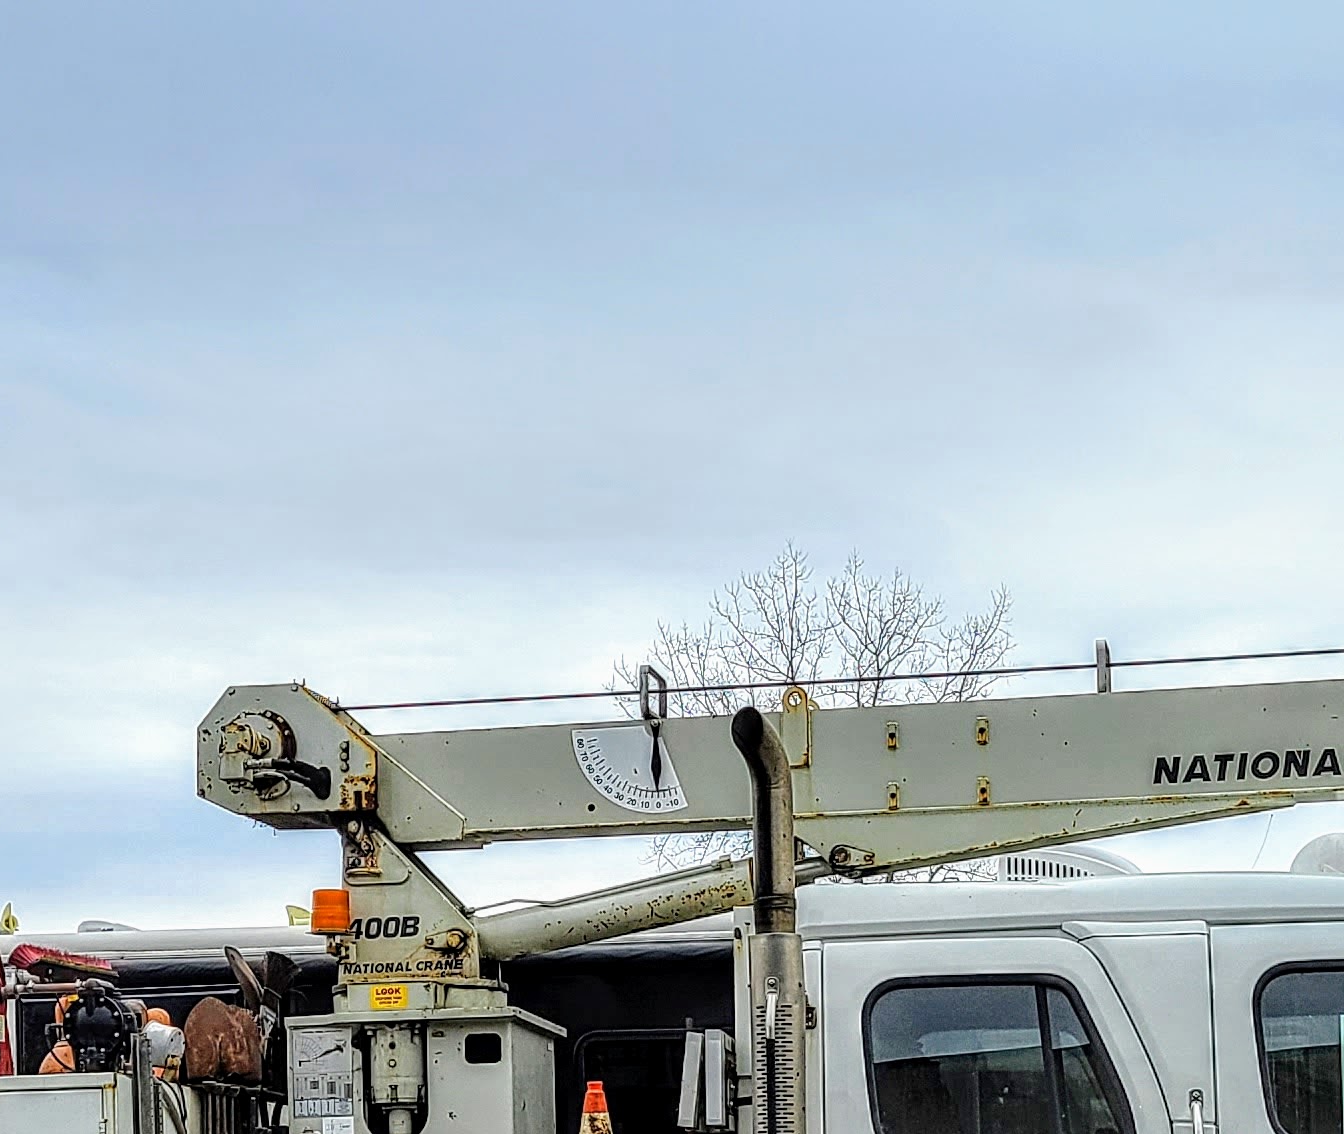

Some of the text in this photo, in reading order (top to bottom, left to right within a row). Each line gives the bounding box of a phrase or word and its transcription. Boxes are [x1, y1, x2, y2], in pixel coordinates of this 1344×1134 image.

[348, 916, 420, 940] 400B
[343, 958, 464, 975] NATIONAL CRANE
[375, 987, 402, 996] LOOK
